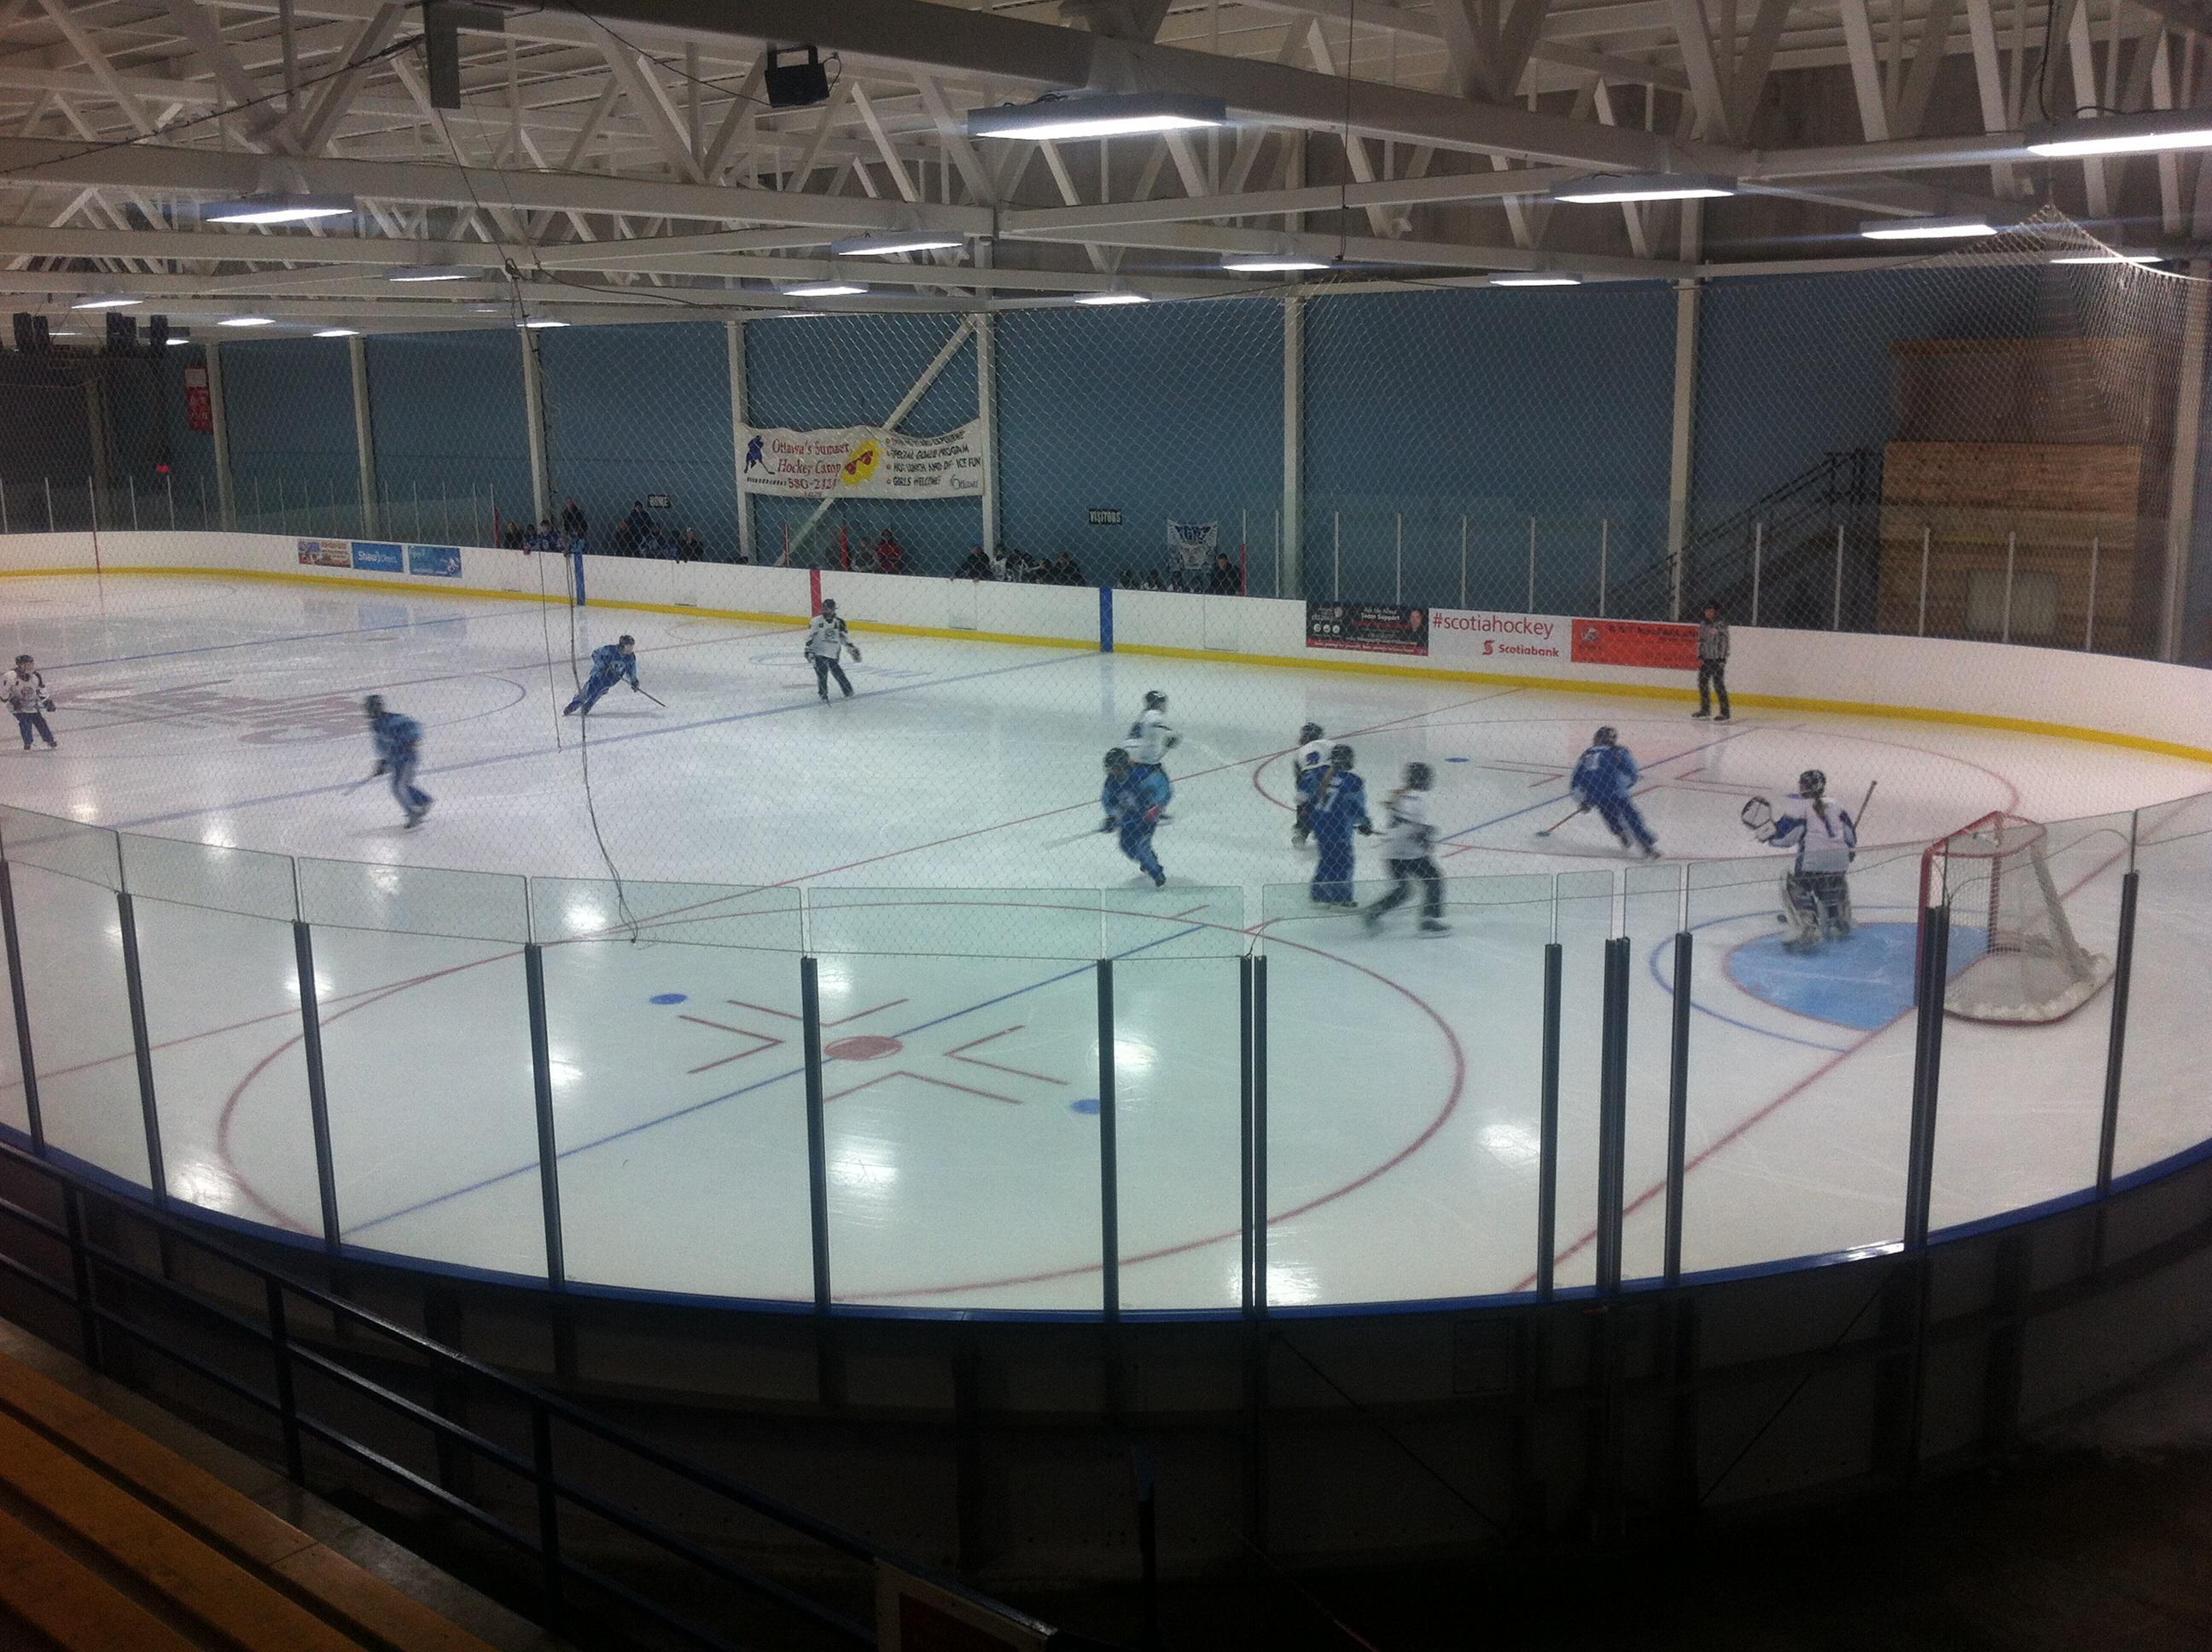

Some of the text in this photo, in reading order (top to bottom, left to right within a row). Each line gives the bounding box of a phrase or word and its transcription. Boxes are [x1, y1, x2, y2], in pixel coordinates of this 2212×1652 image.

[772, 439, 812, 455] Ottawa's
[777, 458, 841, 477] Hockey Camp
[928, 462, 942, 472] AND
[956, 458, 968, 468] ICE
[968, 457, 981, 468] FUN
[893, 476, 911, 486] GIRLS
[1090, 510, 1121, 524] VISITORS
[1433, 613, 1554, 640] #scotiahockey
[1499, 644, 1560, 657] Scotiabank
